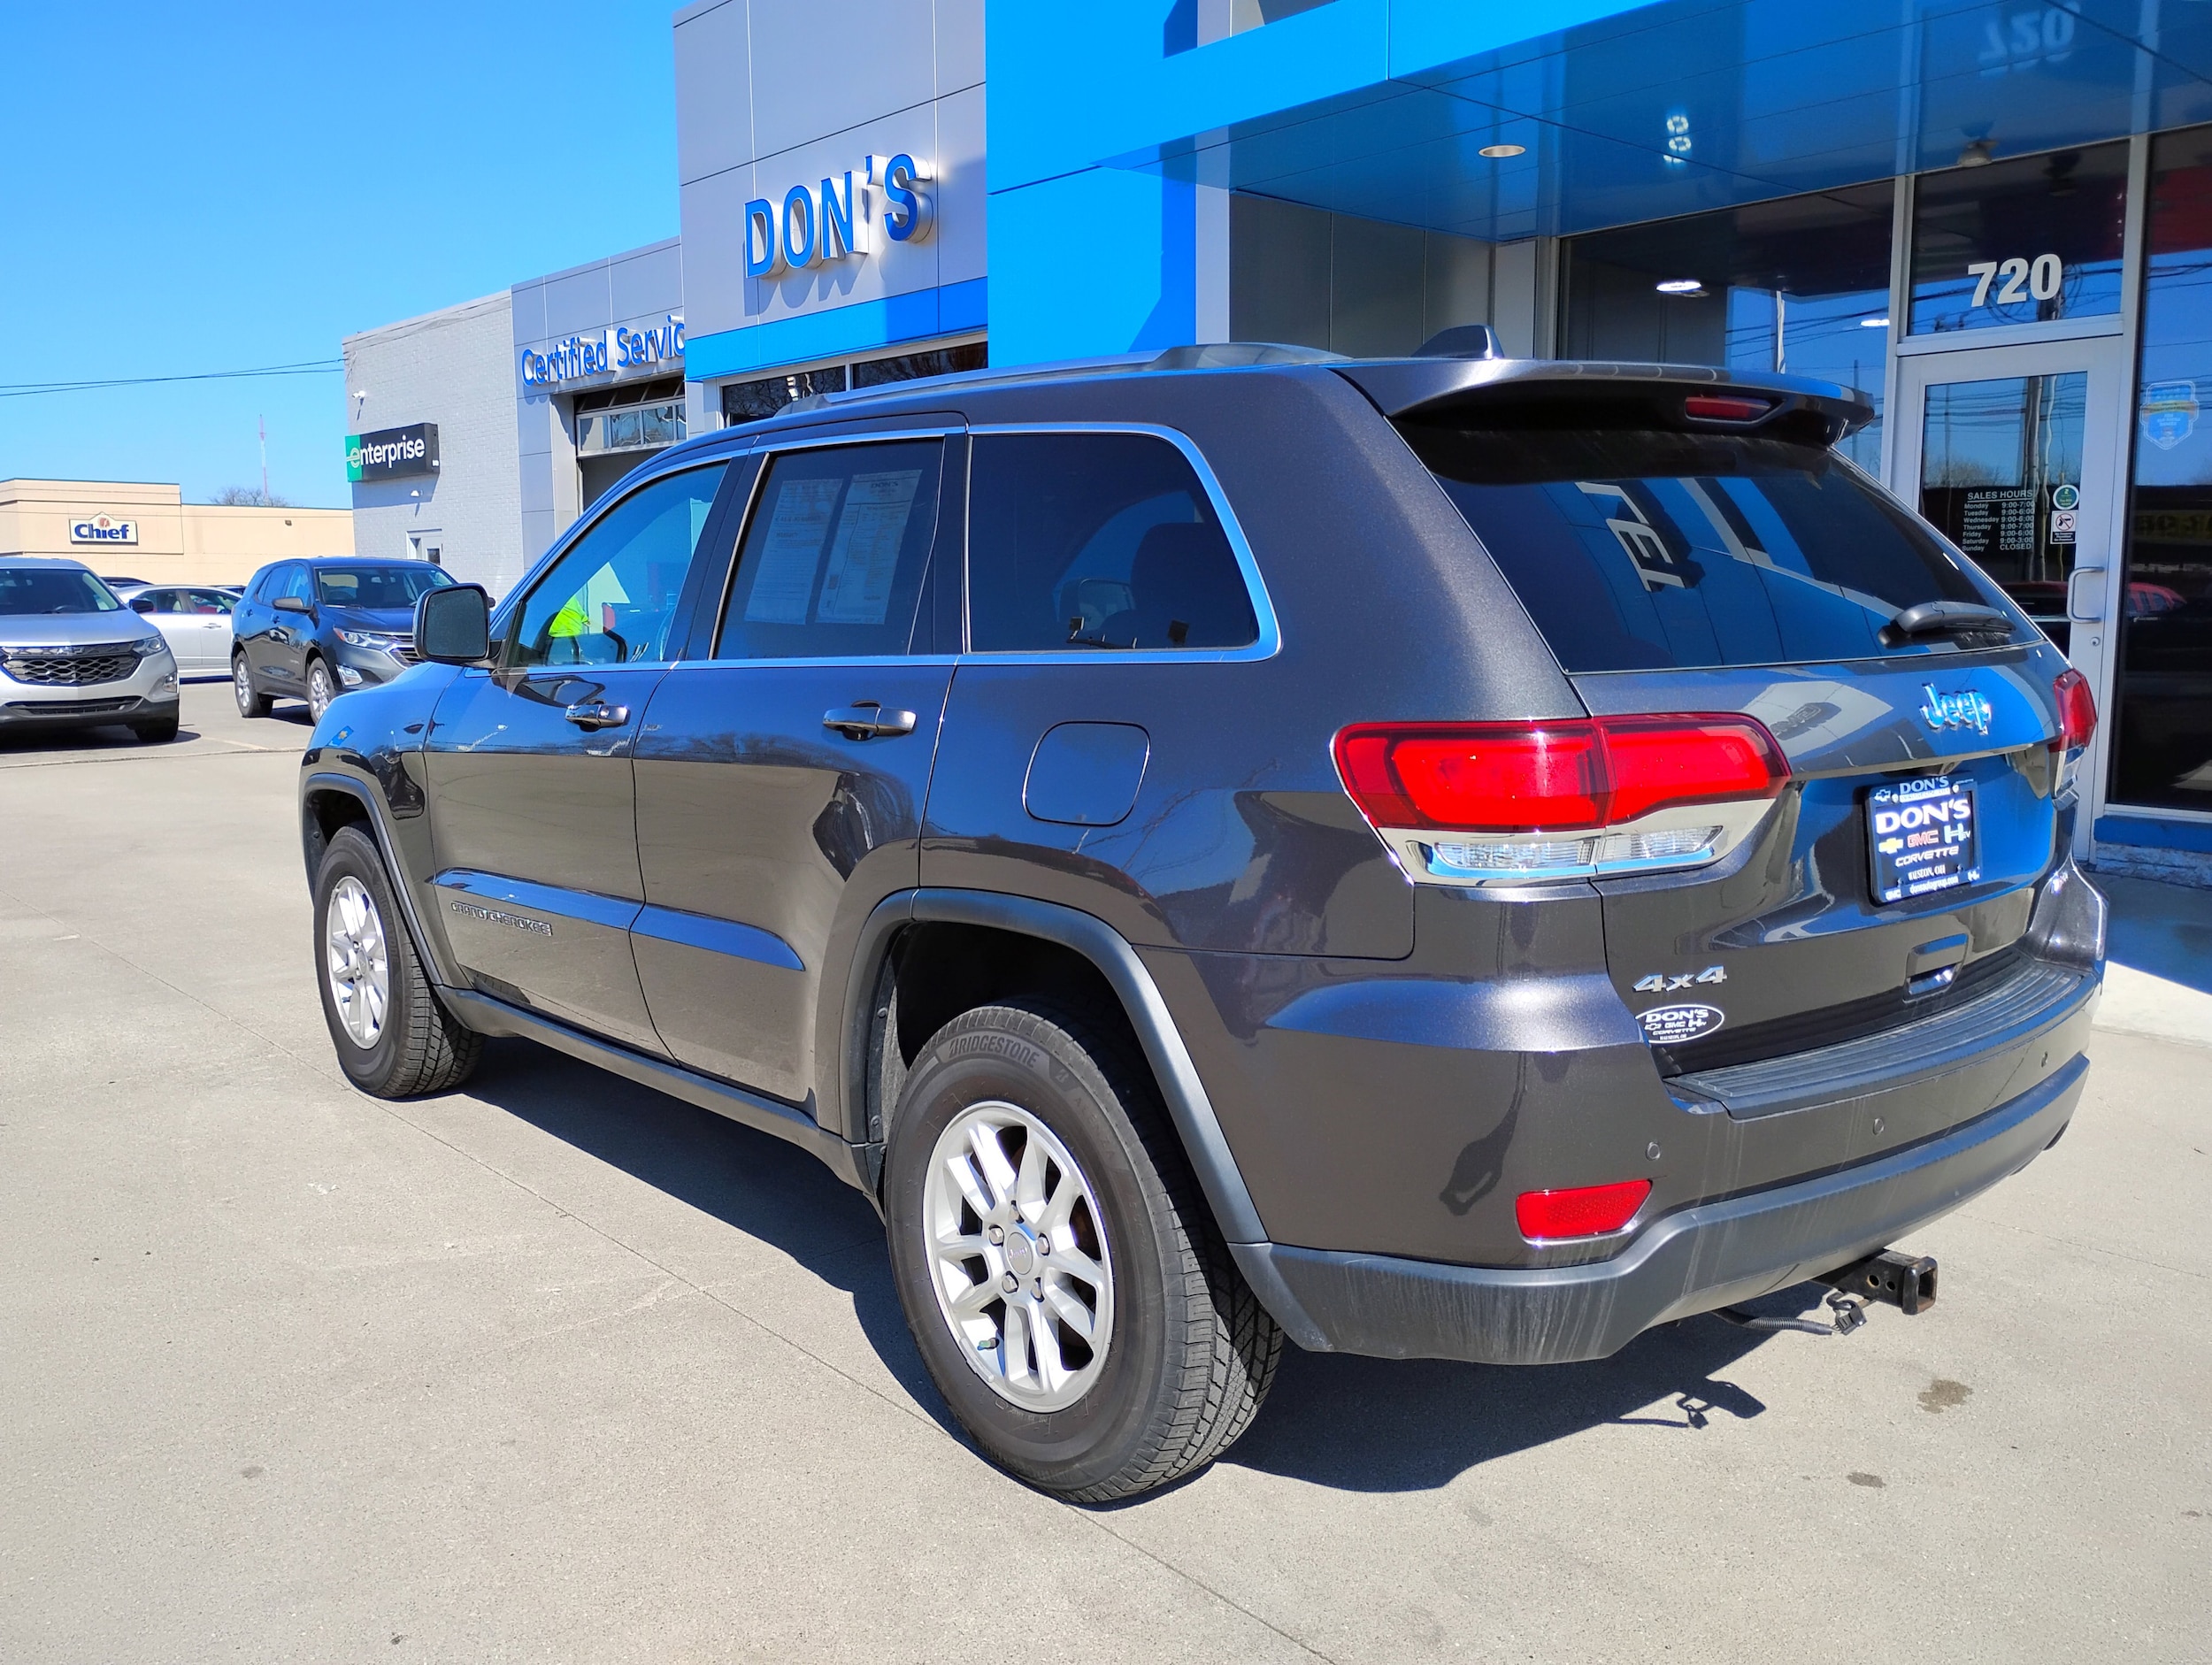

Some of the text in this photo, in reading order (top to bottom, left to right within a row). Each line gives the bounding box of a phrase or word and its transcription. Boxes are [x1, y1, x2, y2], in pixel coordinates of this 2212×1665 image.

[744, 153, 922, 279] DON'S
[1967, 253, 2062, 308] 720
[521, 329, 611, 387] Certified
[346, 434, 425, 469] enterprise
[1967, 489, 2033, 501] SALES HOURS
[74, 524, 129, 540] Chief
[1918, 682, 1992, 736] Jeep
[1900, 776, 1949, 794] DON'S
[1875, 798, 1972, 835] DON'S
[1907, 830, 1939, 848] GMC
[1895, 846, 1960, 868] CORVETTE
[450, 900, 553, 937] GRAND CHEROKEE
[1632, 965, 1728, 993] 4x4
[1646, 1009, 1709, 1023] DON'S
[948, 1034, 1041, 1069] BRIDGESTONE
